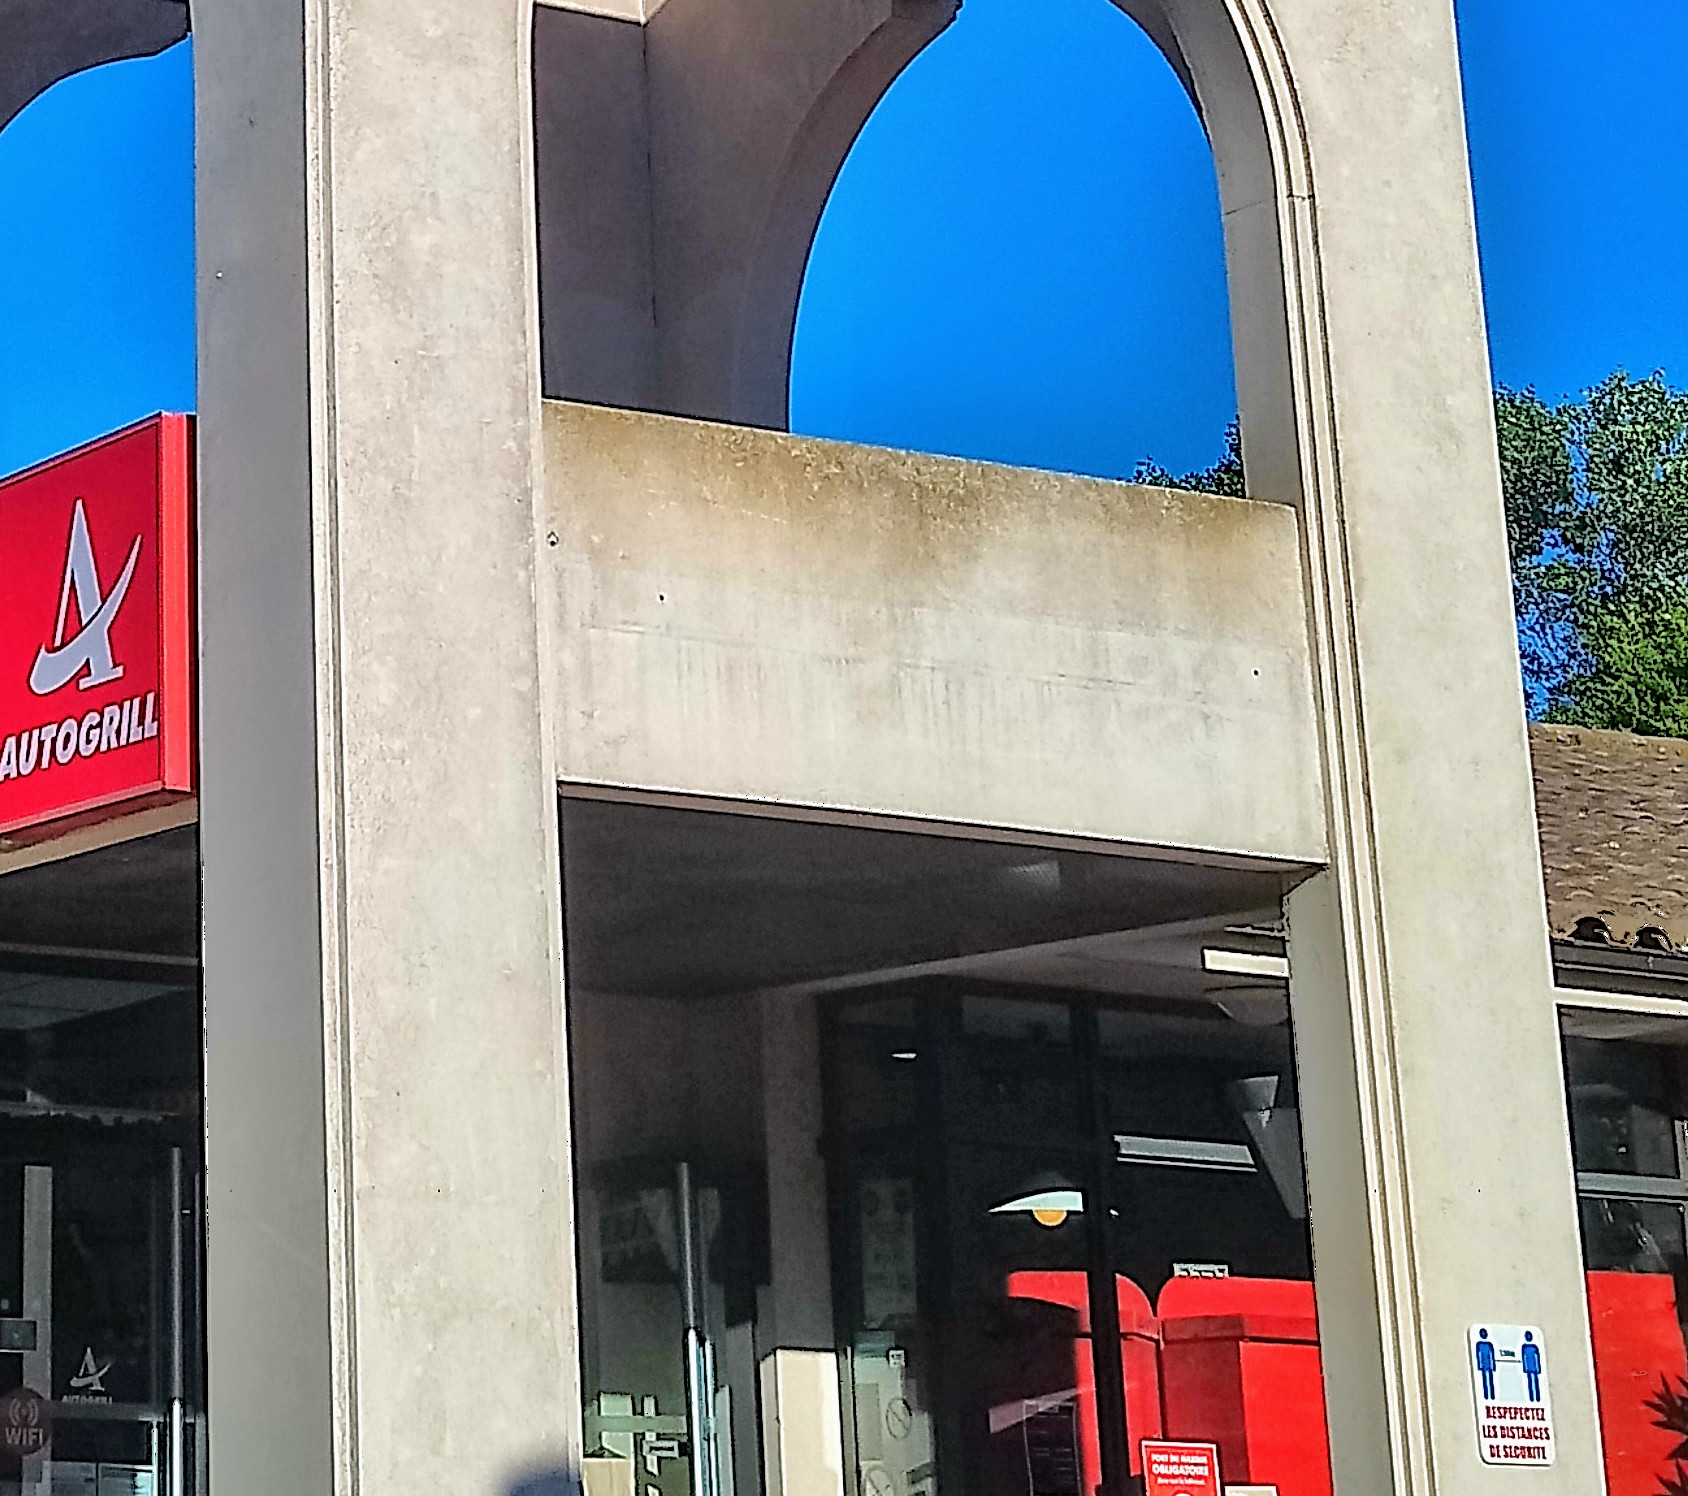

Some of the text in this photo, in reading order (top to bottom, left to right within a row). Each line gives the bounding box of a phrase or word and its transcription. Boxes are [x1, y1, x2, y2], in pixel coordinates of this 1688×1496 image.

[5, 1427, 44, 1446] WIFI
[1482, 1424, 1551, 1440] LES DISTANCES
[1489, 1444, 1502, 1458] DE
